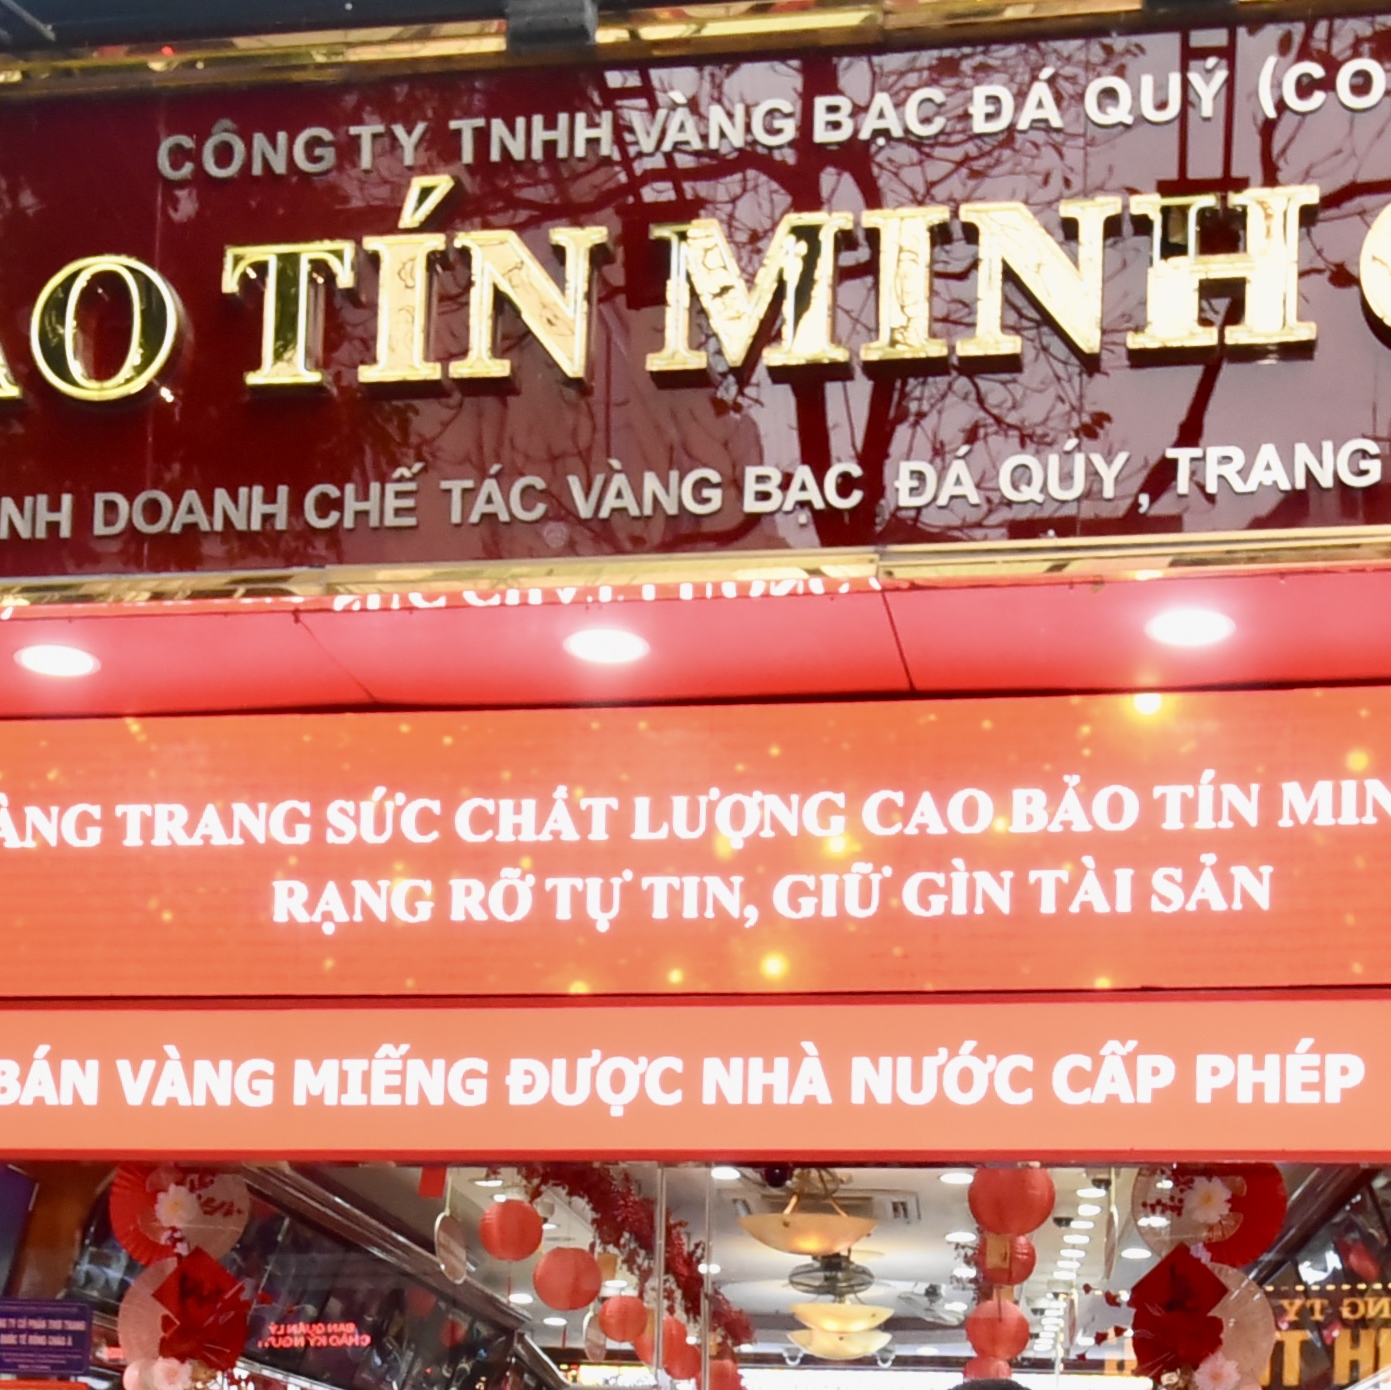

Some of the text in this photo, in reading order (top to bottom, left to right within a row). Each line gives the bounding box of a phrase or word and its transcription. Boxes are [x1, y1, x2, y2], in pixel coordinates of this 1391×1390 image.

[157, 118, 337, 180] CÔNG
[349, 121, 429, 170] TY
[448, 110, 613, 165] TNHH
[630, 90, 797, 154] VÀNG
[813, 86, 948, 147] BẠC
[968, 66, 1065, 135] ĐÁ
[1084, 57, 1229, 126] QUÝ
[221, 174, 609, 386] TÍN
[646, 184, 1320, 372] MINH
[92, 485, 289, 538] DOANH
[303, 462, 425, 529] CHẾ
[439, 464, 549, 525] TÁC
[567, 459, 723, 520] VÀNG
[743, 462, 865, 526] BẠC
[894, 444, 982, 509] ĐÁ
[1165, 437, 1383, 495] TRANG
[114, 800, 312, 847] TRANG
[325, 785, 441, 844] SỨC
[454, 784, 619, 843] CHẤT
[630, 786, 847, 850] LƯỢNG
[861, 787, 995, 838] CAO
[1009, 773, 1141, 834] BẢO
[1151, 768, 1261, 831] TÍN
[271, 878, 434, 935] RẠNG
[544, 868, 634, 934] TỰ
[641, 874, 760, 928] TIN,
[771, 861, 893, 920] GIỮ
[901, 857, 1014, 918] GÌN
[1028, 855, 1135, 914] TÀI
[1150, 852, 1274, 914] SẢN
[116, 1044, 275, 1107] VÀNG
[292, 1043, 488, 1107] MIẾNG
[505, 1048, 684, 1117] ĐƯỢC
[702, 1040, 833, 1105] NHÀ
[850, 1039, 1034, 1106] NƯỚC
[1051, 1039, 1176, 1105] CẤP
[1195, 1037, 1367, 1103] PHÉP
